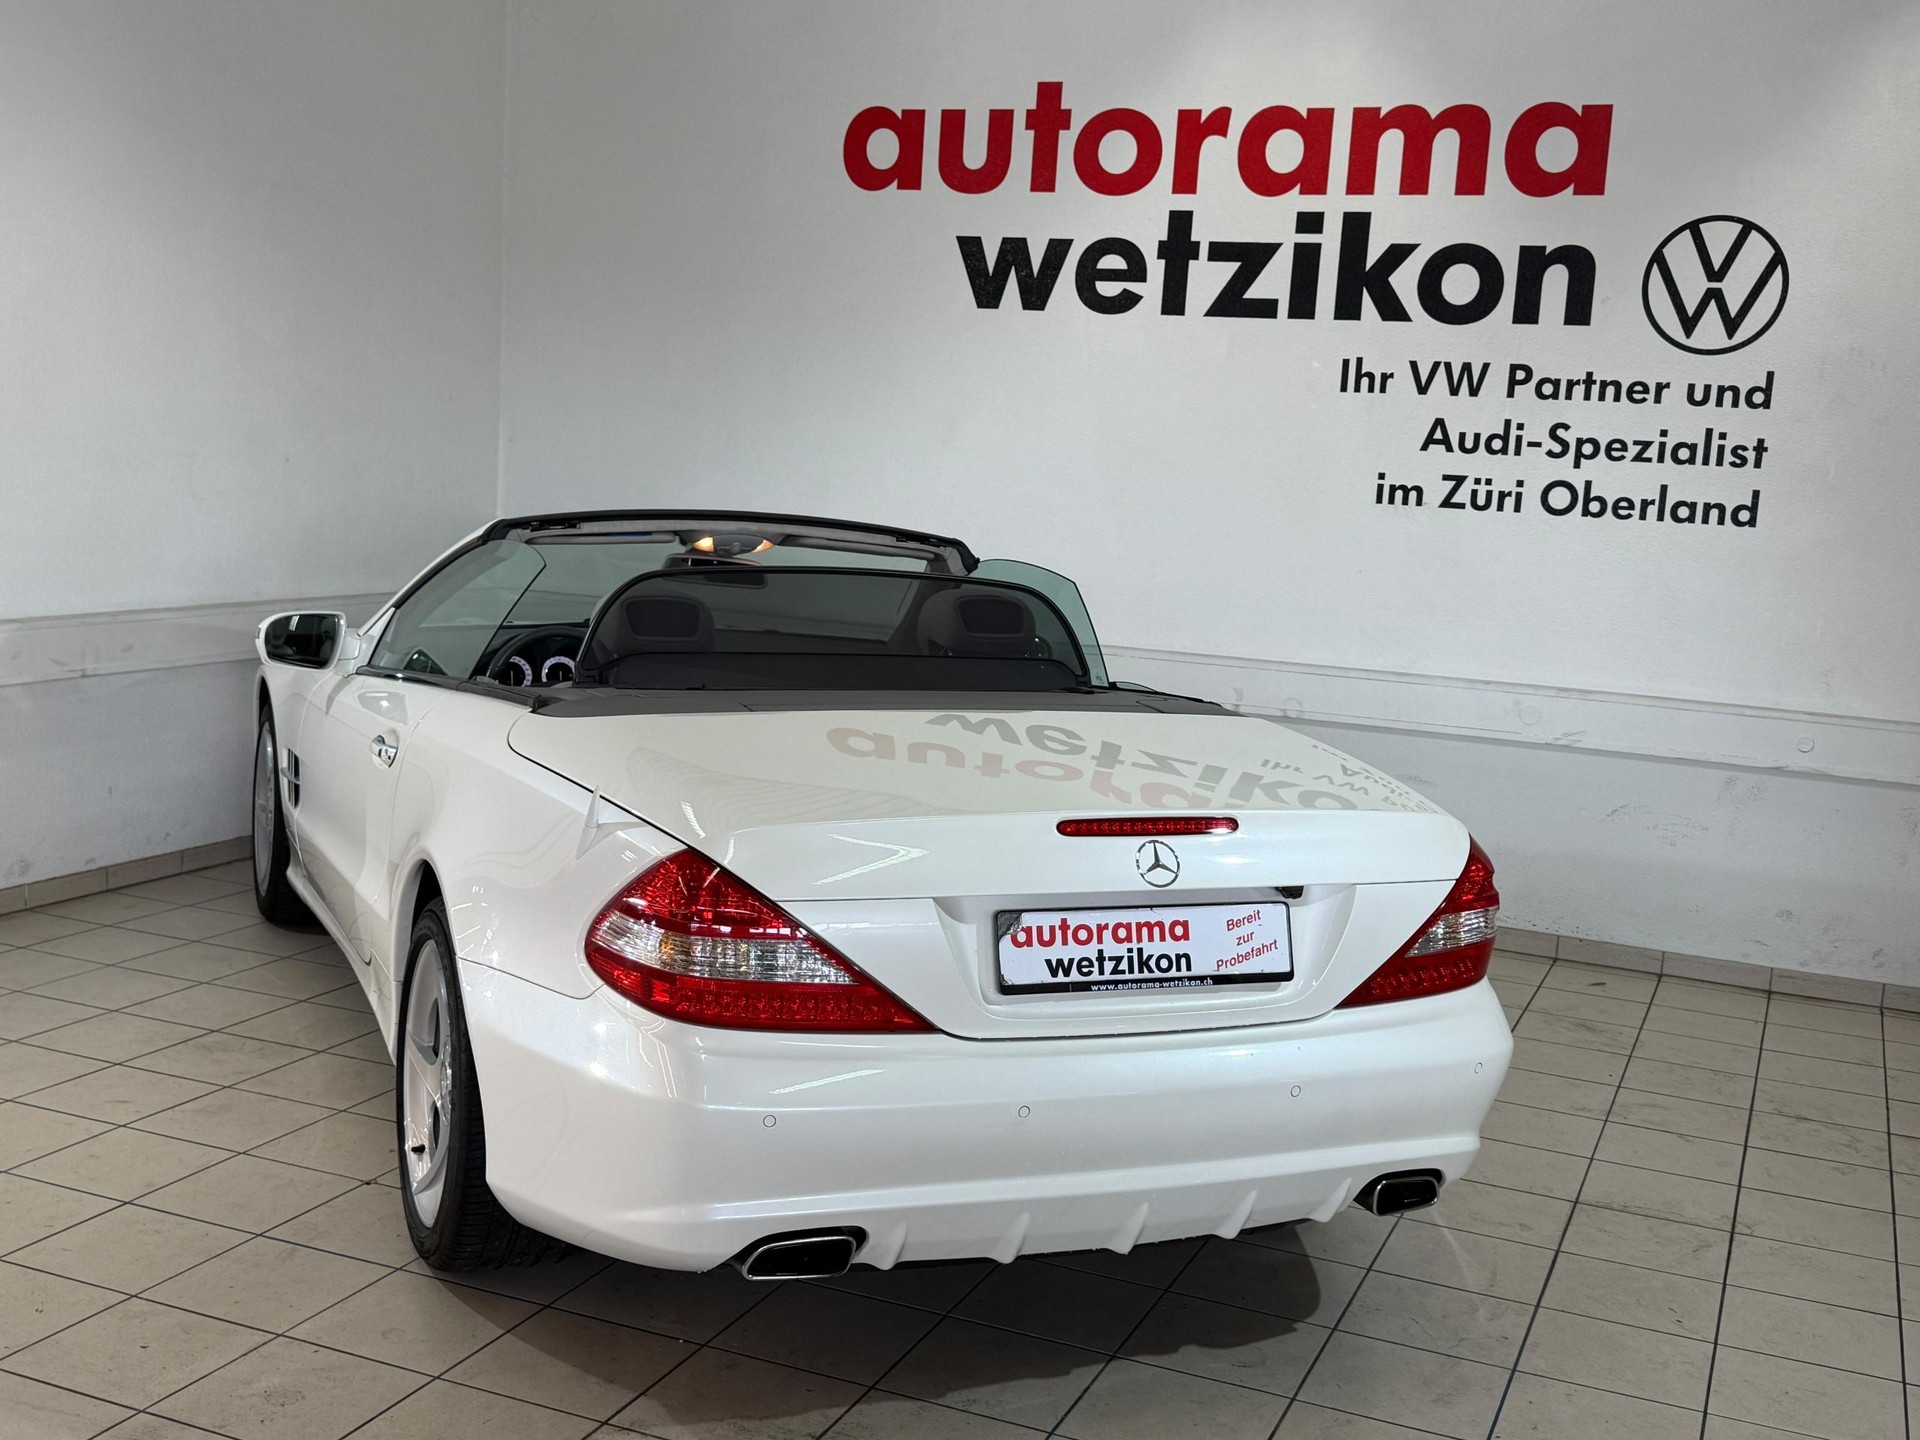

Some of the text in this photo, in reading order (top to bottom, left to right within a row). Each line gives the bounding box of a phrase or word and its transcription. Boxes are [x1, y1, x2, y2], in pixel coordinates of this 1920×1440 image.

[843, 82, 1613, 198] autorama
[956, 210, 1596, 326] wetzikon
[1340, 357, 1774, 410] Ihr VW Partner und
[1420, 417, 1769, 469] Audi-Spezialist
[1375, 472, 1761, 528] im Züri Oberland
[1010, 917, 1190, 949] autorama
[1226, 909, 1262, 932] Bereit
[1216, 938, 1279, 971] Probefahrt
[1235, 931, 1255, 947] zur
[1044, 947, 1193, 979] wetzikon
[1090, 977, 1214, 991] www.autorama-wetzikon.ch
